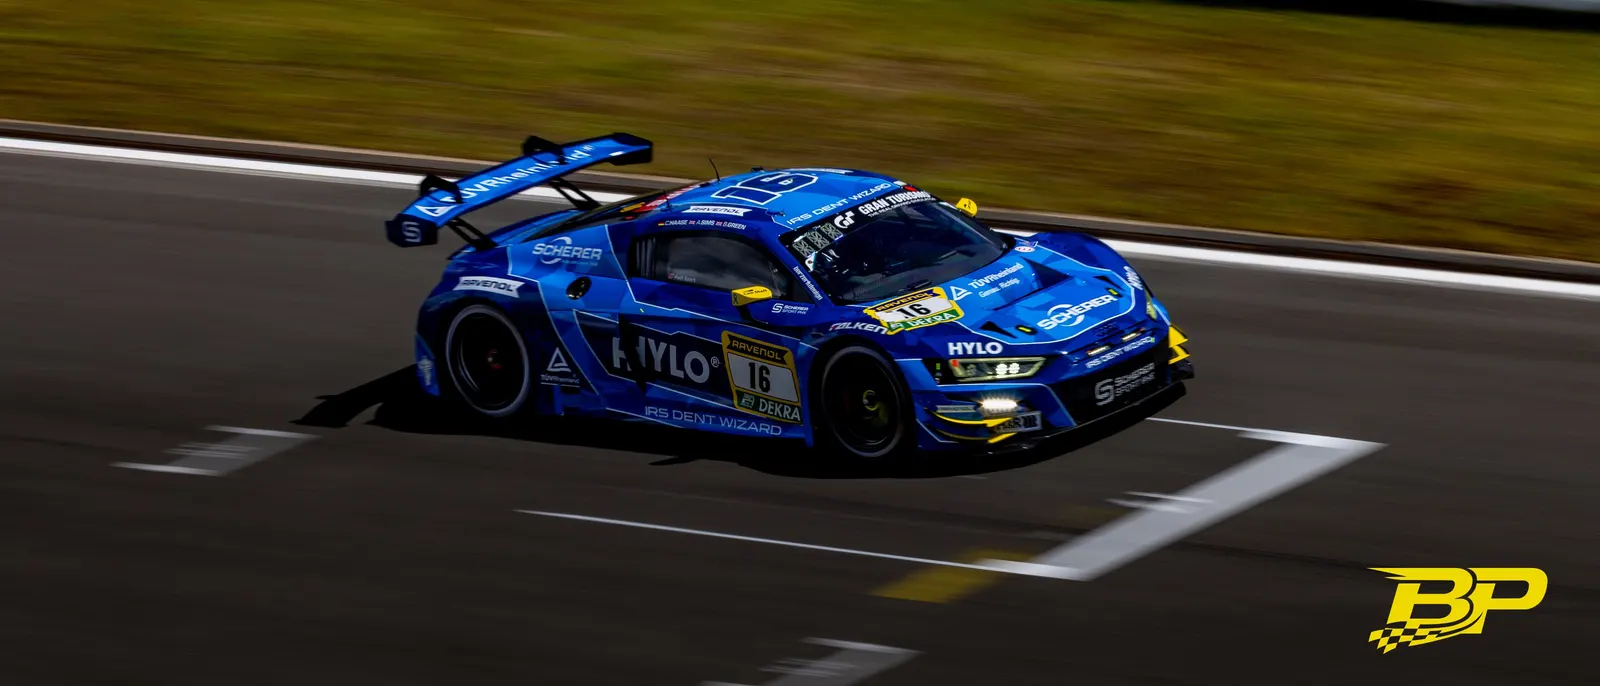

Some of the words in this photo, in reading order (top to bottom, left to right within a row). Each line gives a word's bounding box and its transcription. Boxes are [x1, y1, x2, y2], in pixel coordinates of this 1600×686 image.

[711, 171, 818, 205] 16
[786, 213, 812, 225] IRS
[812, 198, 848, 216] DENT
[849, 183, 892, 201] WIZARD
[858, 199, 890, 215] GRAN
[885, 190, 931, 204] TURISMO
[532, 243, 602, 260] SCHERER
[461, 279, 516, 292] RAVENOL
[968, 262, 1024, 289] TÜVRheinland
[876, 292, 933, 311] RAVENOL
[896, 303, 931, 319] 16
[1037, 294, 1118, 330] SCHERER
[828, 321, 888, 335] FALKEN
[906, 312, 957, 327] DEKRA
[732, 340, 782, 361] RAVENOL
[947, 341, 1003, 355] HYLO
[748, 362, 771, 393] 16
[1114, 363, 1155, 387] SCHERER
[644, 405, 669, 418] IRS
[672, 409, 716, 425] DENT
[720, 416, 782, 436] WIZARD
[759, 398, 801, 421] DEKRA
